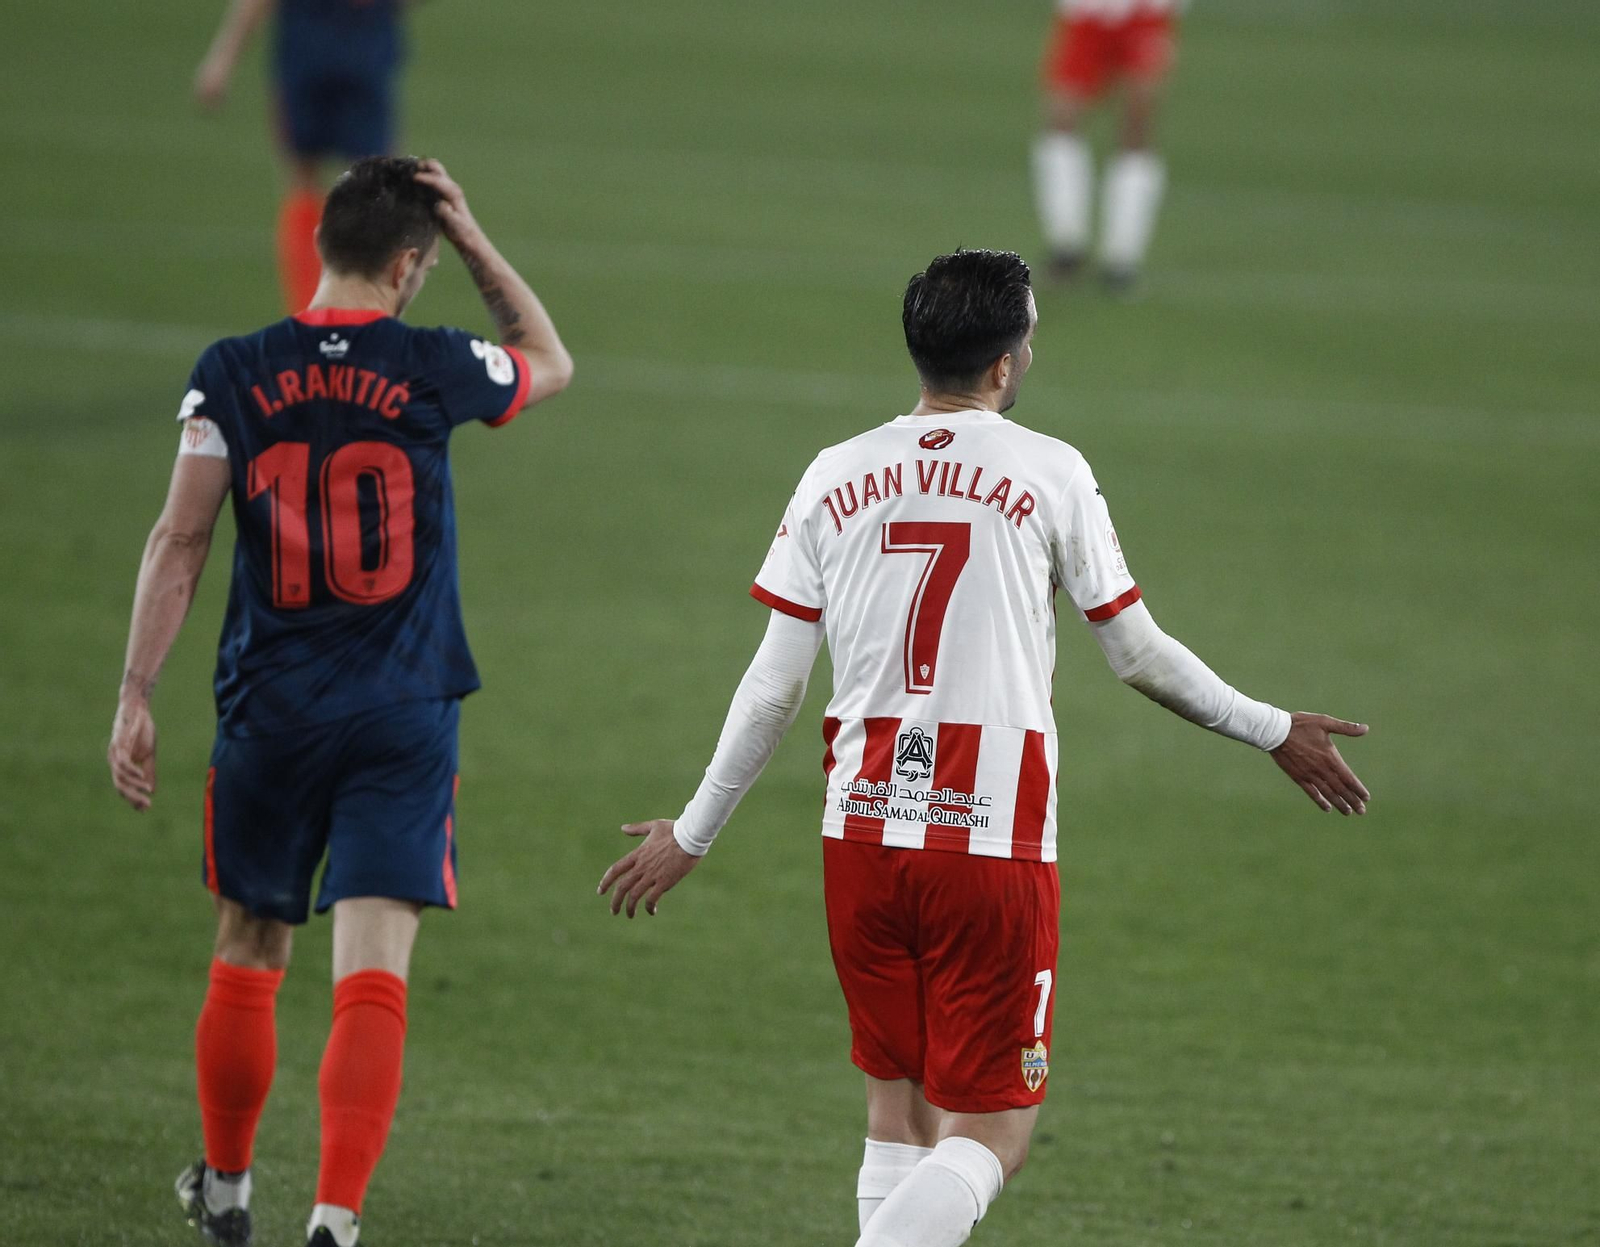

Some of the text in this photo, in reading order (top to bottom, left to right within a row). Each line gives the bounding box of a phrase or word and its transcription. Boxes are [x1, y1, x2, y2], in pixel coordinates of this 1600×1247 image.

[247, 441, 415, 609] 10
[822, 459, 1036, 536] JUAN VILLAR
[881, 521, 972, 695] 7
[837, 797, 873, 816] ABDUL
[873, 801, 918, 822] SAMAD
[930, 807, 990, 828] QURASHI
